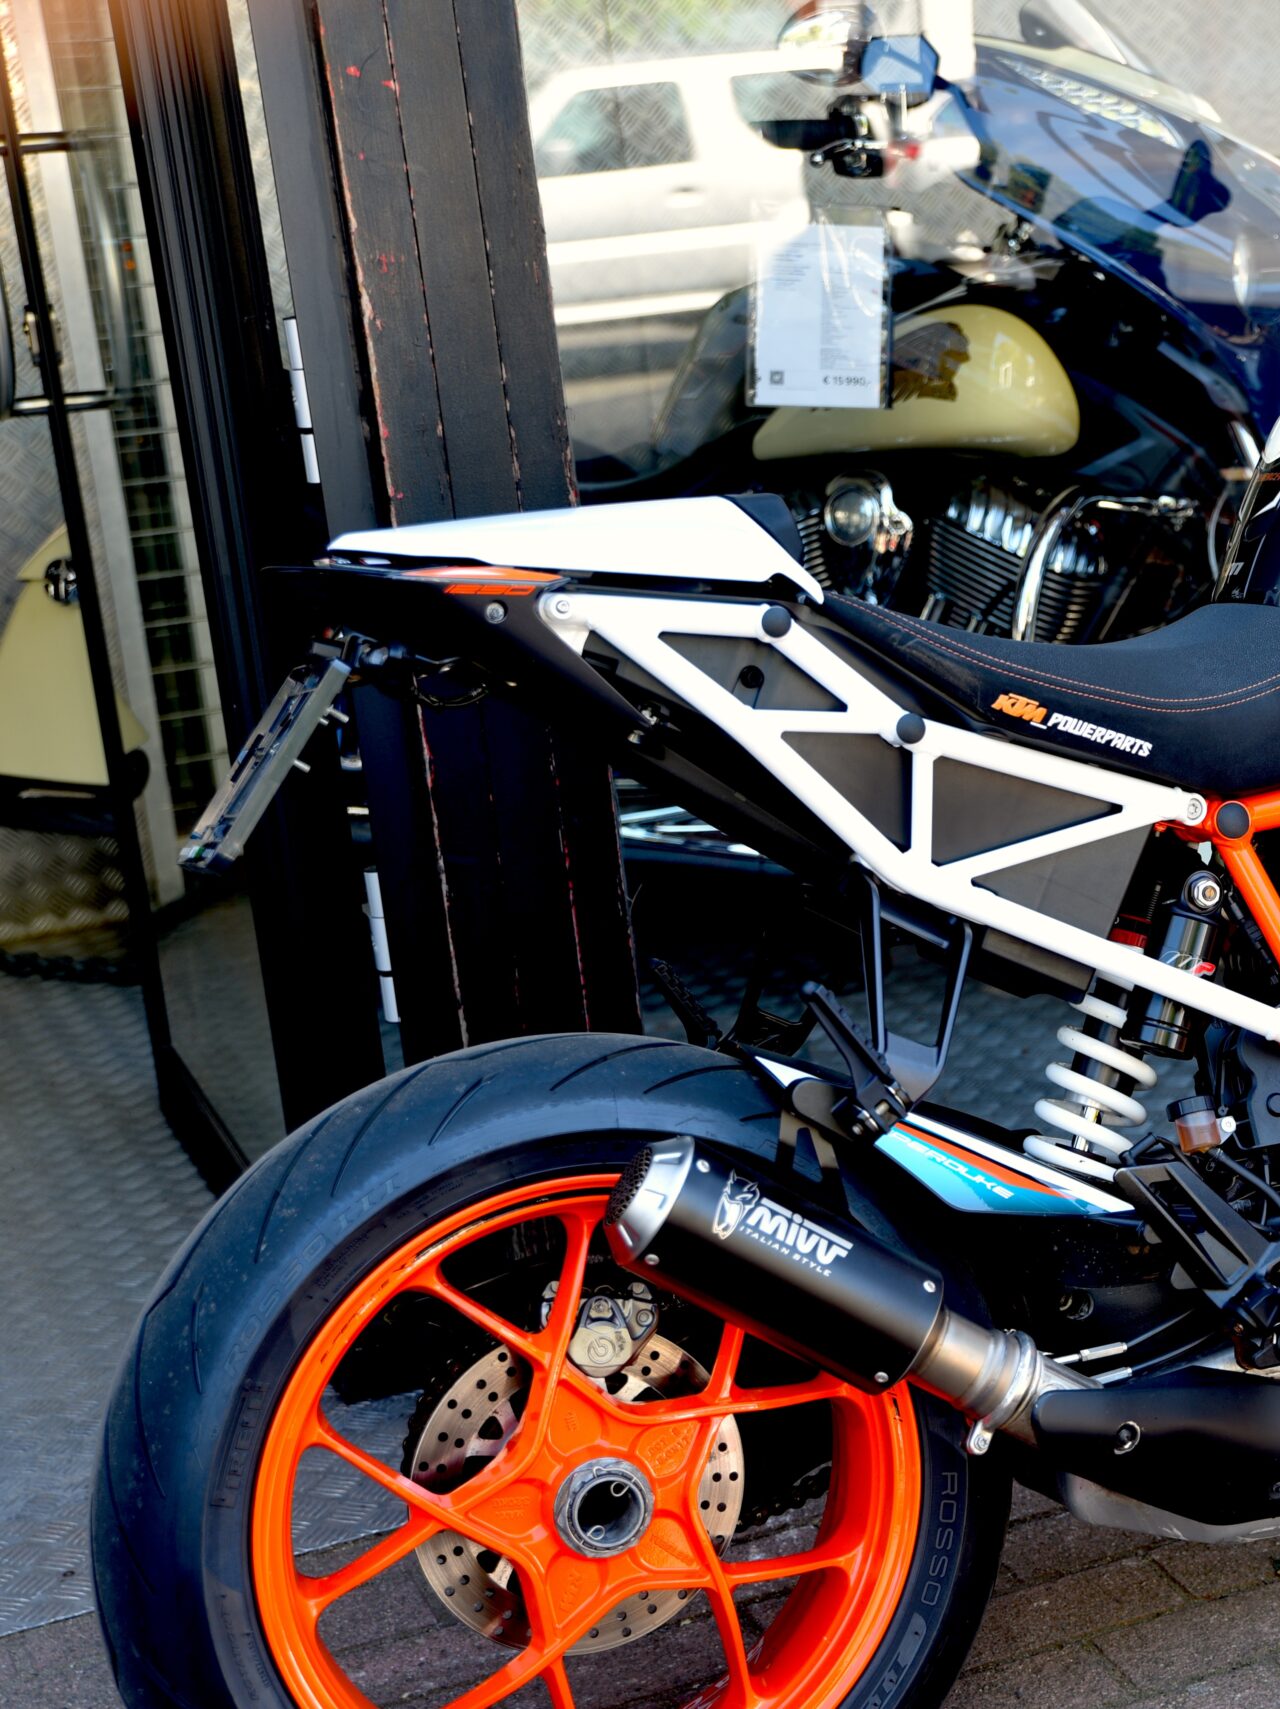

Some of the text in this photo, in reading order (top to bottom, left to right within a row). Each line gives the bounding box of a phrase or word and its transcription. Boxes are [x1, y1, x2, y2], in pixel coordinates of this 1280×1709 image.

[991, 693, 1153, 758] KTM POWERPARTS
[739, 1225, 832, 1278] ITALIAN STYLE
[921, 1471, 958, 1606] ROSSO
